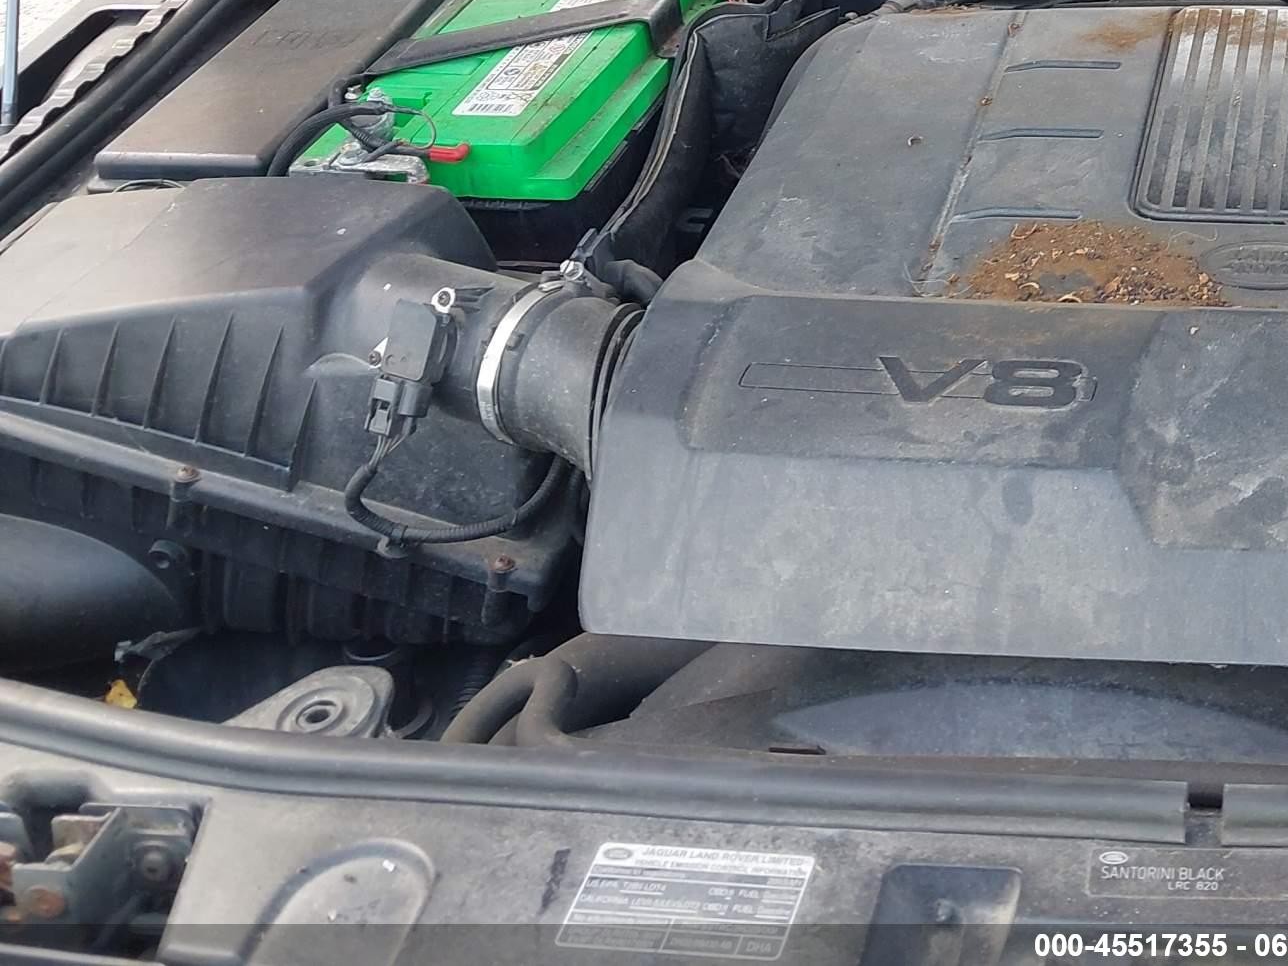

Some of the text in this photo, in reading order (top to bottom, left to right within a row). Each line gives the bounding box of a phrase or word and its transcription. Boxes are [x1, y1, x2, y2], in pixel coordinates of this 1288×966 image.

[878, 356, 1084, 409] V8
[640, 848, 687, 858] JAGUAR
[687, 851, 719, 860] LAND
[721, 853, 760, 862] ROVER
[760, 855, 804, 865] LIMITED
[1101, 866, 1225, 880] SANTORINI BLACK
[1168, 881, 1190, 890] LRC
